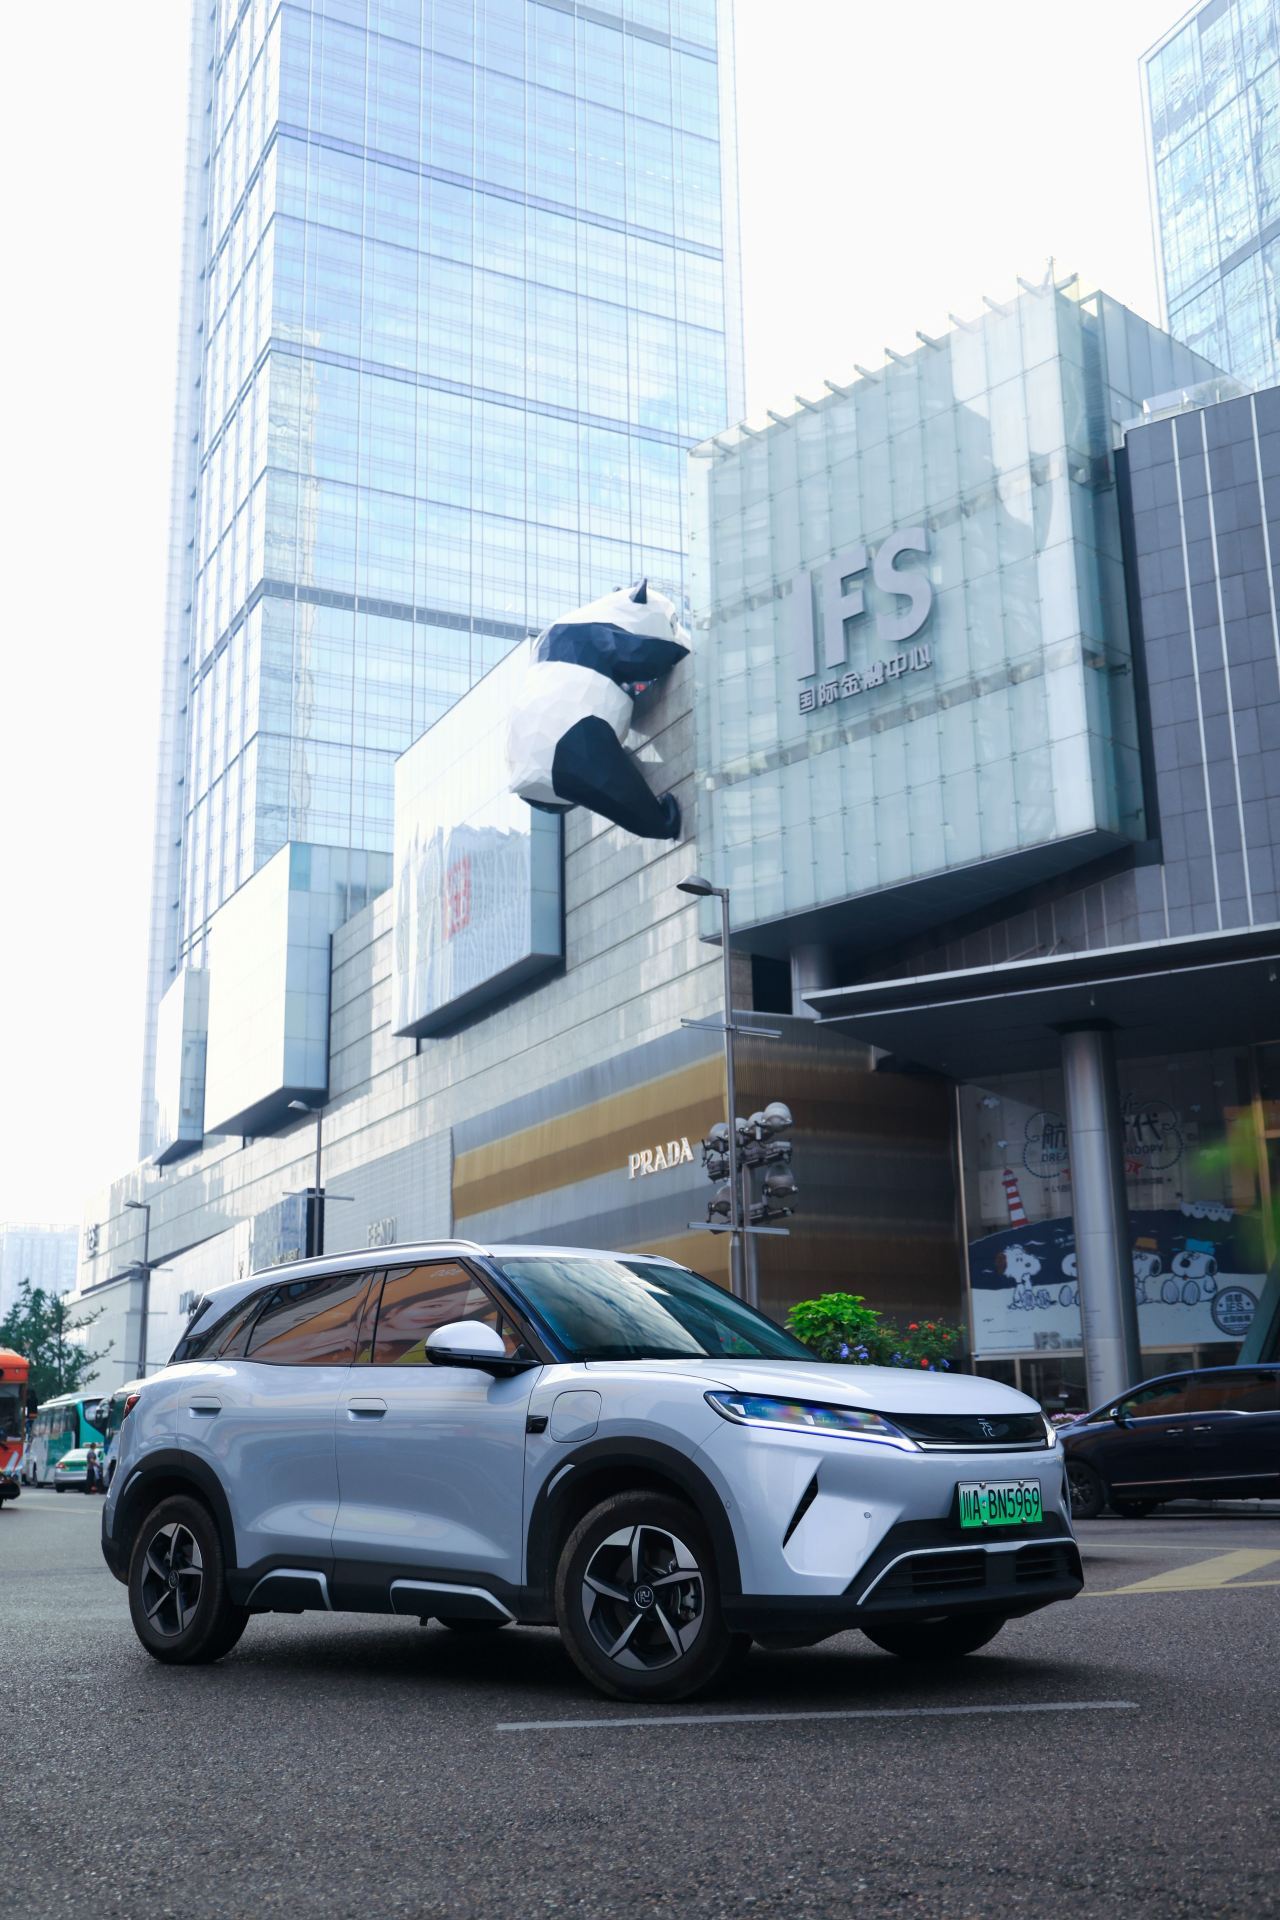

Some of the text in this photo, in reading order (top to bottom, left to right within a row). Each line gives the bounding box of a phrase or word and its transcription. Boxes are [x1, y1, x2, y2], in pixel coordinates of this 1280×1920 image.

[792, 527, 932, 681] IFS
[799, 644, 933, 715] 国际金融中心
[628, 1136, 694, 1180] PRADA
[1040, 1151, 1070, 1163] DREA
